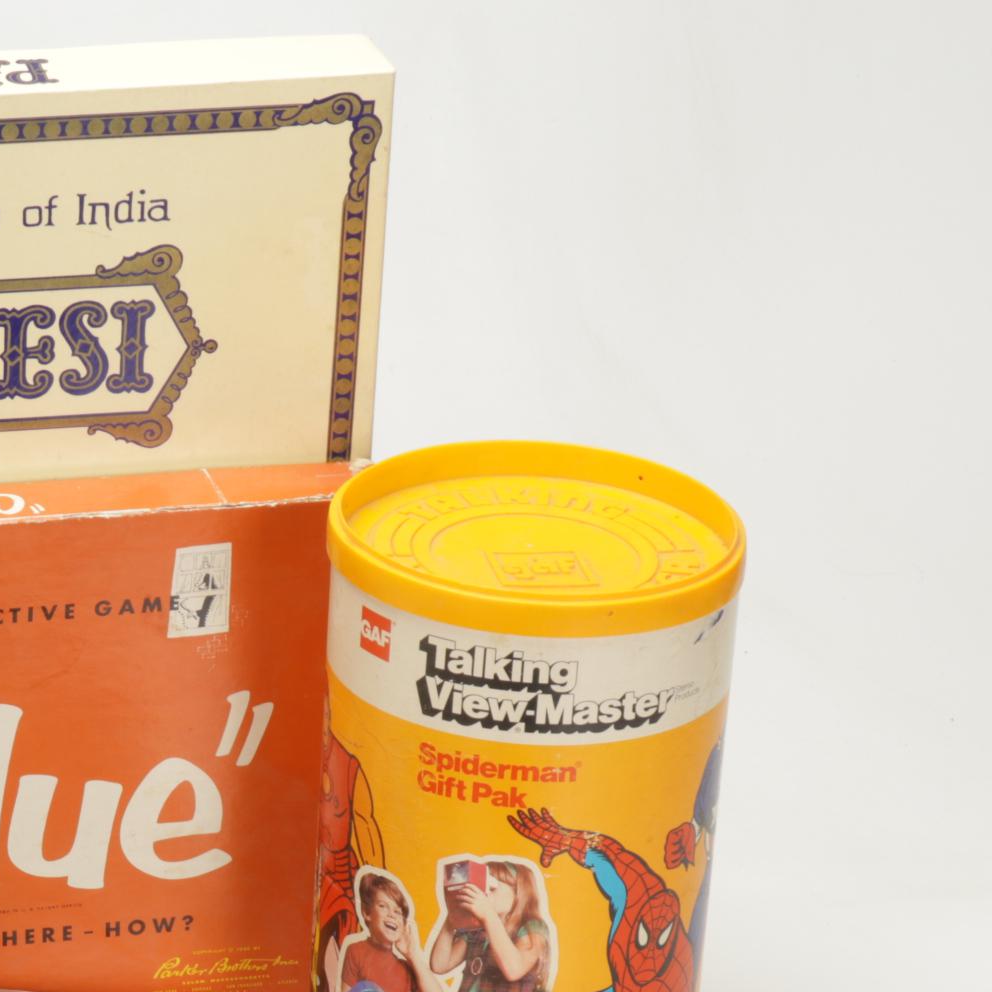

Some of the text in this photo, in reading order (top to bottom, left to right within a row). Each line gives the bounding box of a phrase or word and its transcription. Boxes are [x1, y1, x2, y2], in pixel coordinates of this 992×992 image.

[23, 195, 57, 227] of
[76, 189, 170, 231] India
[94, 594, 181, 618] GAME
[361, 618, 391, 646] GAF
[419, 634, 579, 692] Talking
[417, 675, 676, 734] View-Master
[418, 742, 578, 783] Spiderman
[417, 770, 528, 809] Gift Pak
[104, 915, 195, 938] HOW?
